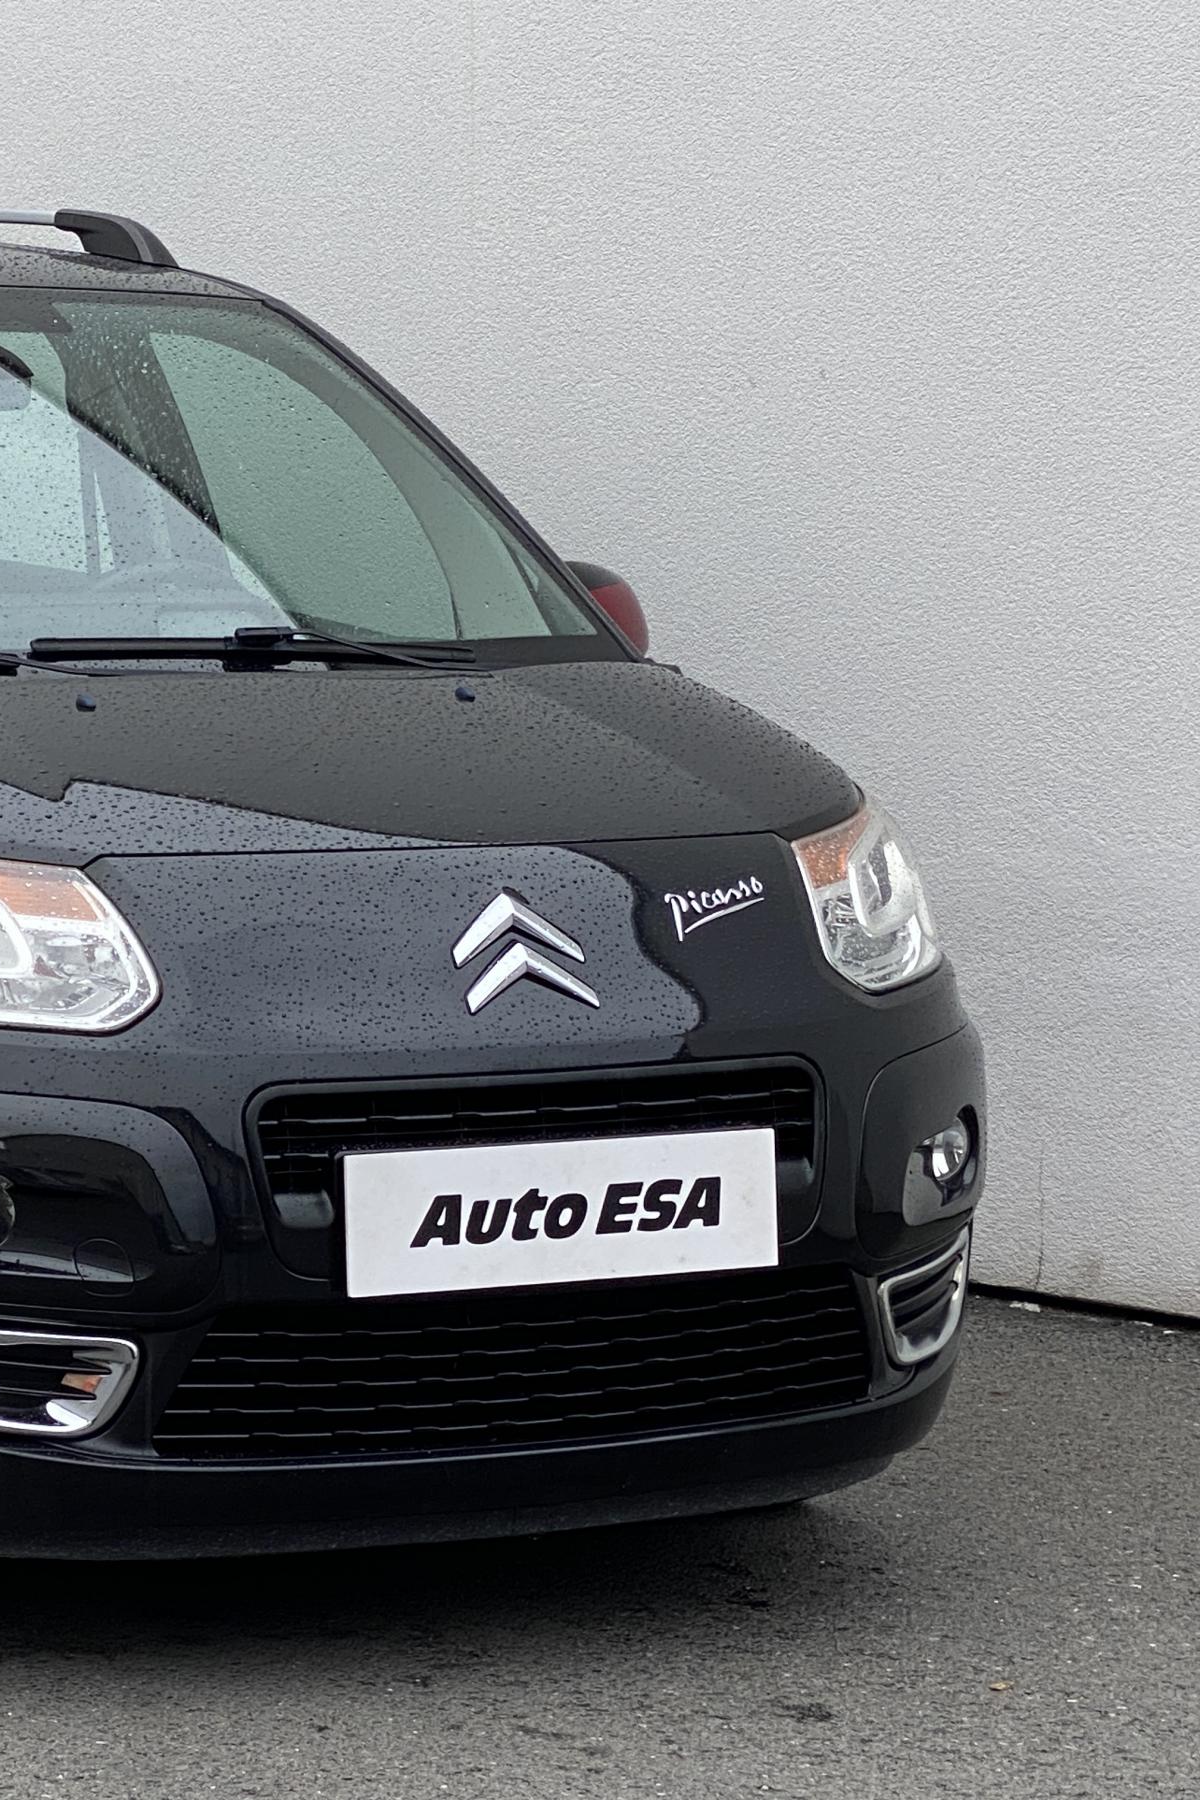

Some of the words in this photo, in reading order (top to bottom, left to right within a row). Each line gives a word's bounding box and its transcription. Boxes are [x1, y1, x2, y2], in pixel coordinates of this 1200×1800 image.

[664, 876, 765, 942] Picasso
[410, 1188, 588, 1248] Auto
[596, 1176, 721, 1235] ESA
